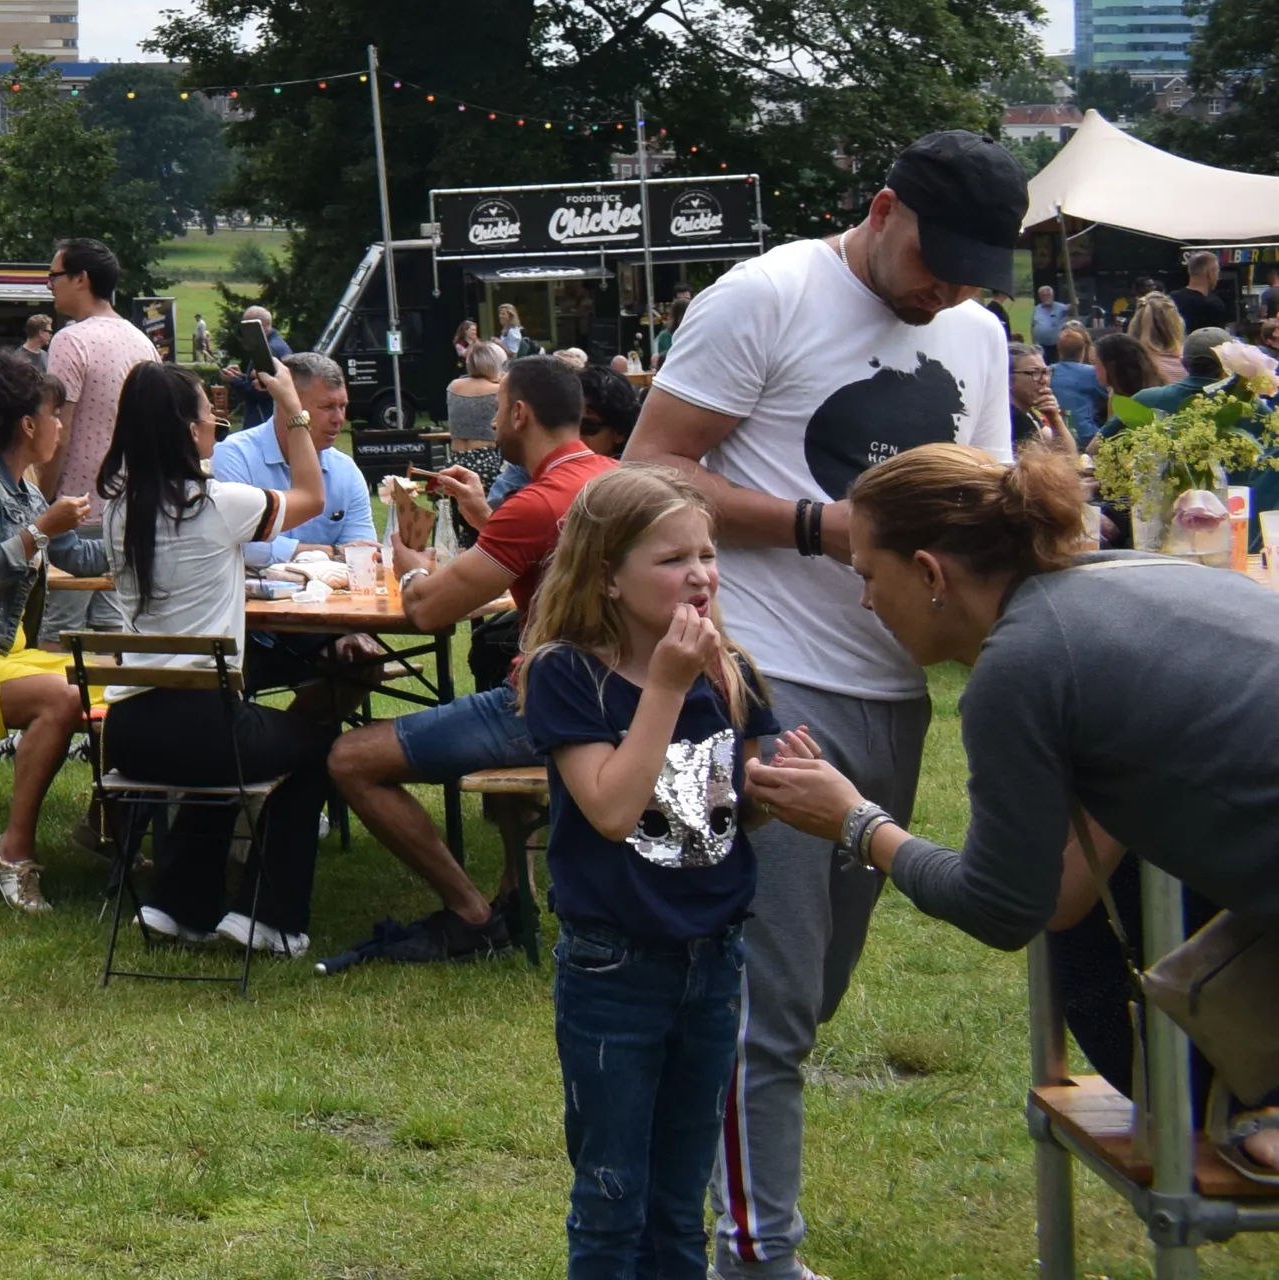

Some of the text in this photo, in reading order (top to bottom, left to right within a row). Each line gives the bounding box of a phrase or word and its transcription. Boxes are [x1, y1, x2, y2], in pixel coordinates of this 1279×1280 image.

[566, 194, 621, 203] FOODTRUCK
[468, 220, 521, 243] Chickies
[548, 202, 642, 241] Chickies
[670, 212, 723, 235] Chickies
[870, 441, 898, 456] CPN
